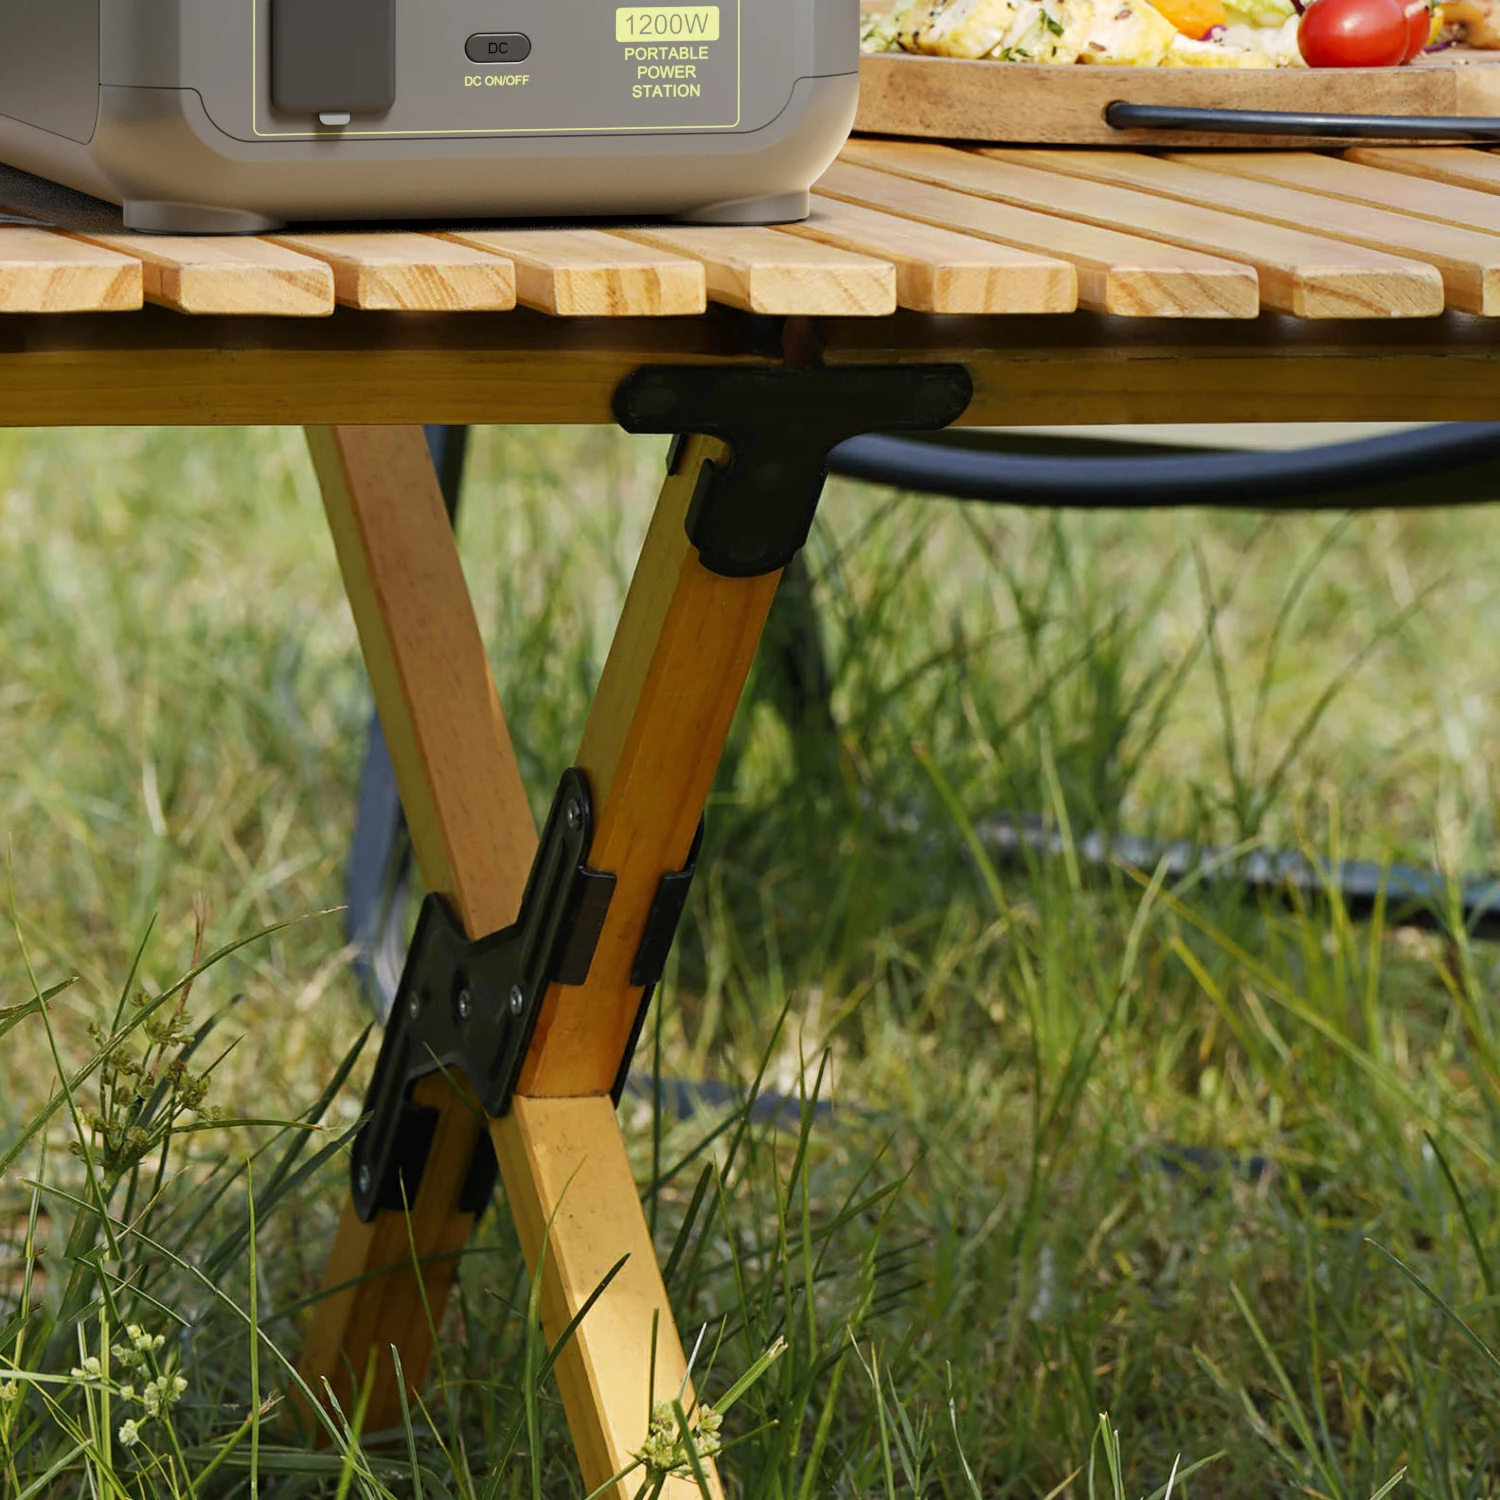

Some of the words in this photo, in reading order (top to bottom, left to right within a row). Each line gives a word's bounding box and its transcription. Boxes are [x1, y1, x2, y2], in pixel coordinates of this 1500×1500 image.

[624, 12, 709, 36] 1200W
[487, 41, 509, 54] DC
[624, 46, 709, 61] PORTABLE
[637, 64, 697, 79] POWER
[464, 76, 481, 88] DC
[485, 75, 530, 87] ON/OFF
[631, 83, 701, 98] STATION
